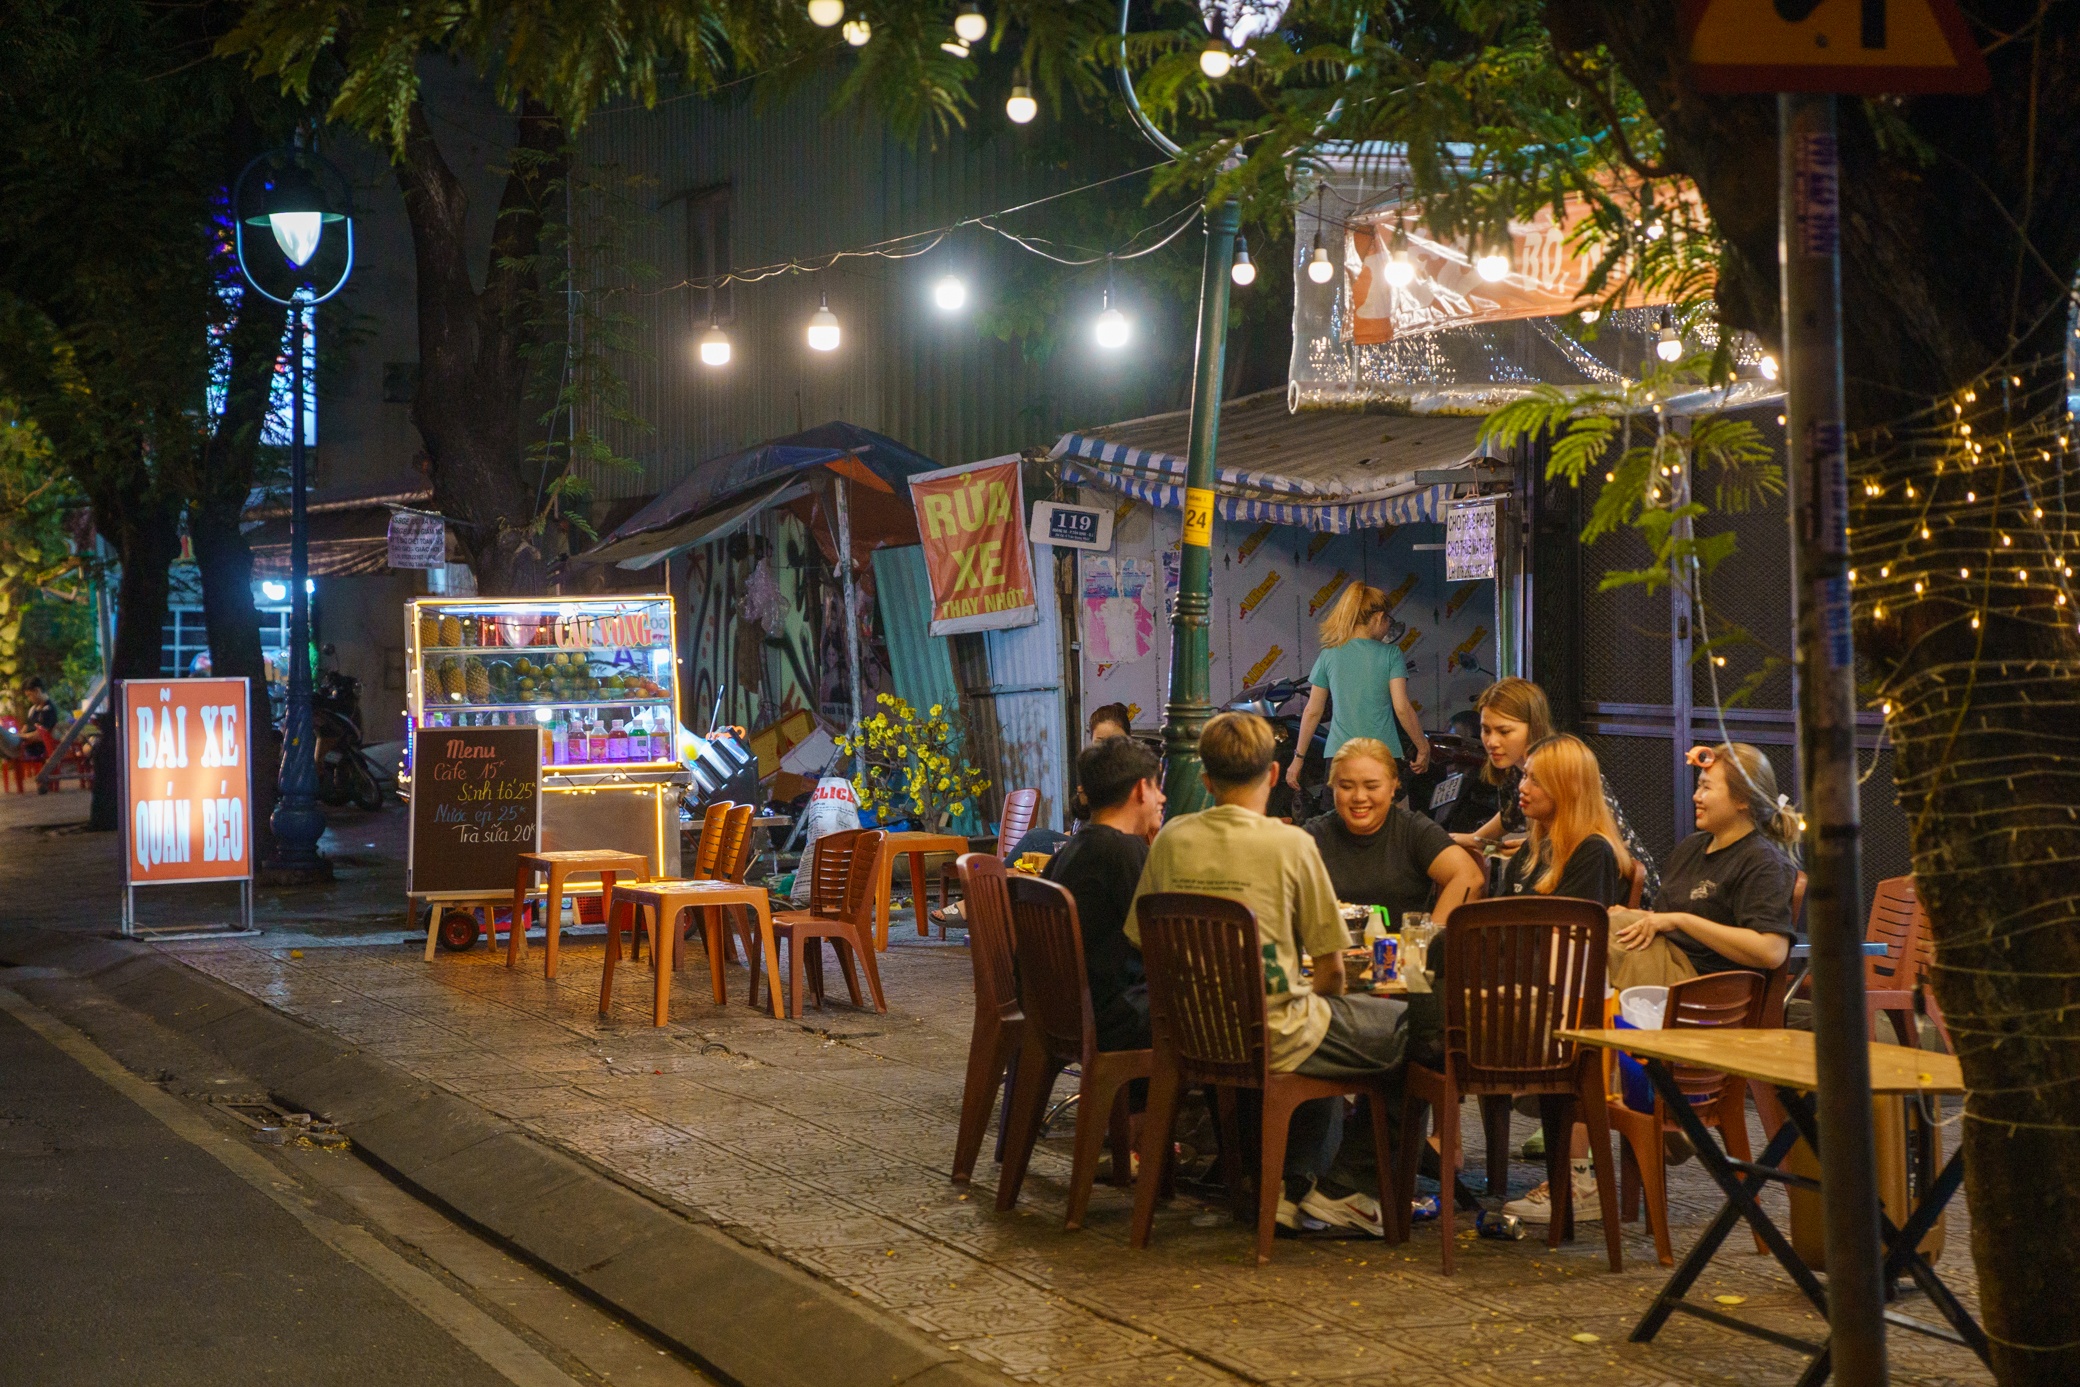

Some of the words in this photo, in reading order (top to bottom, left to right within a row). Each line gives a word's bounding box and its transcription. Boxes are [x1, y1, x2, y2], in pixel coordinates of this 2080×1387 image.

[923, 472, 1013, 540] RỬA
[1186, 509, 1206, 529] 24
[1057, 513, 1092, 531] 119
[951, 540, 1006, 592] XE
[941, 599, 979, 619] THAY
[984, 587, 1026, 613] NHỚT
[598, 603, 652, 648] VỒNG
[136, 687, 189, 769] BÃI
[200, 704, 240, 768] XE
[446, 739, 496, 758] Menu
[457, 780, 492, 801] Sinh
[496, 778, 516, 800] tố
[135, 780, 191, 873] QUÁN
[202, 780, 243, 862] BÉO
[434, 802, 467, 823] Nước
[475, 803, 493, 828] ép
[452, 824, 479, 843] Trà
[483, 821, 509, 842] sữa
